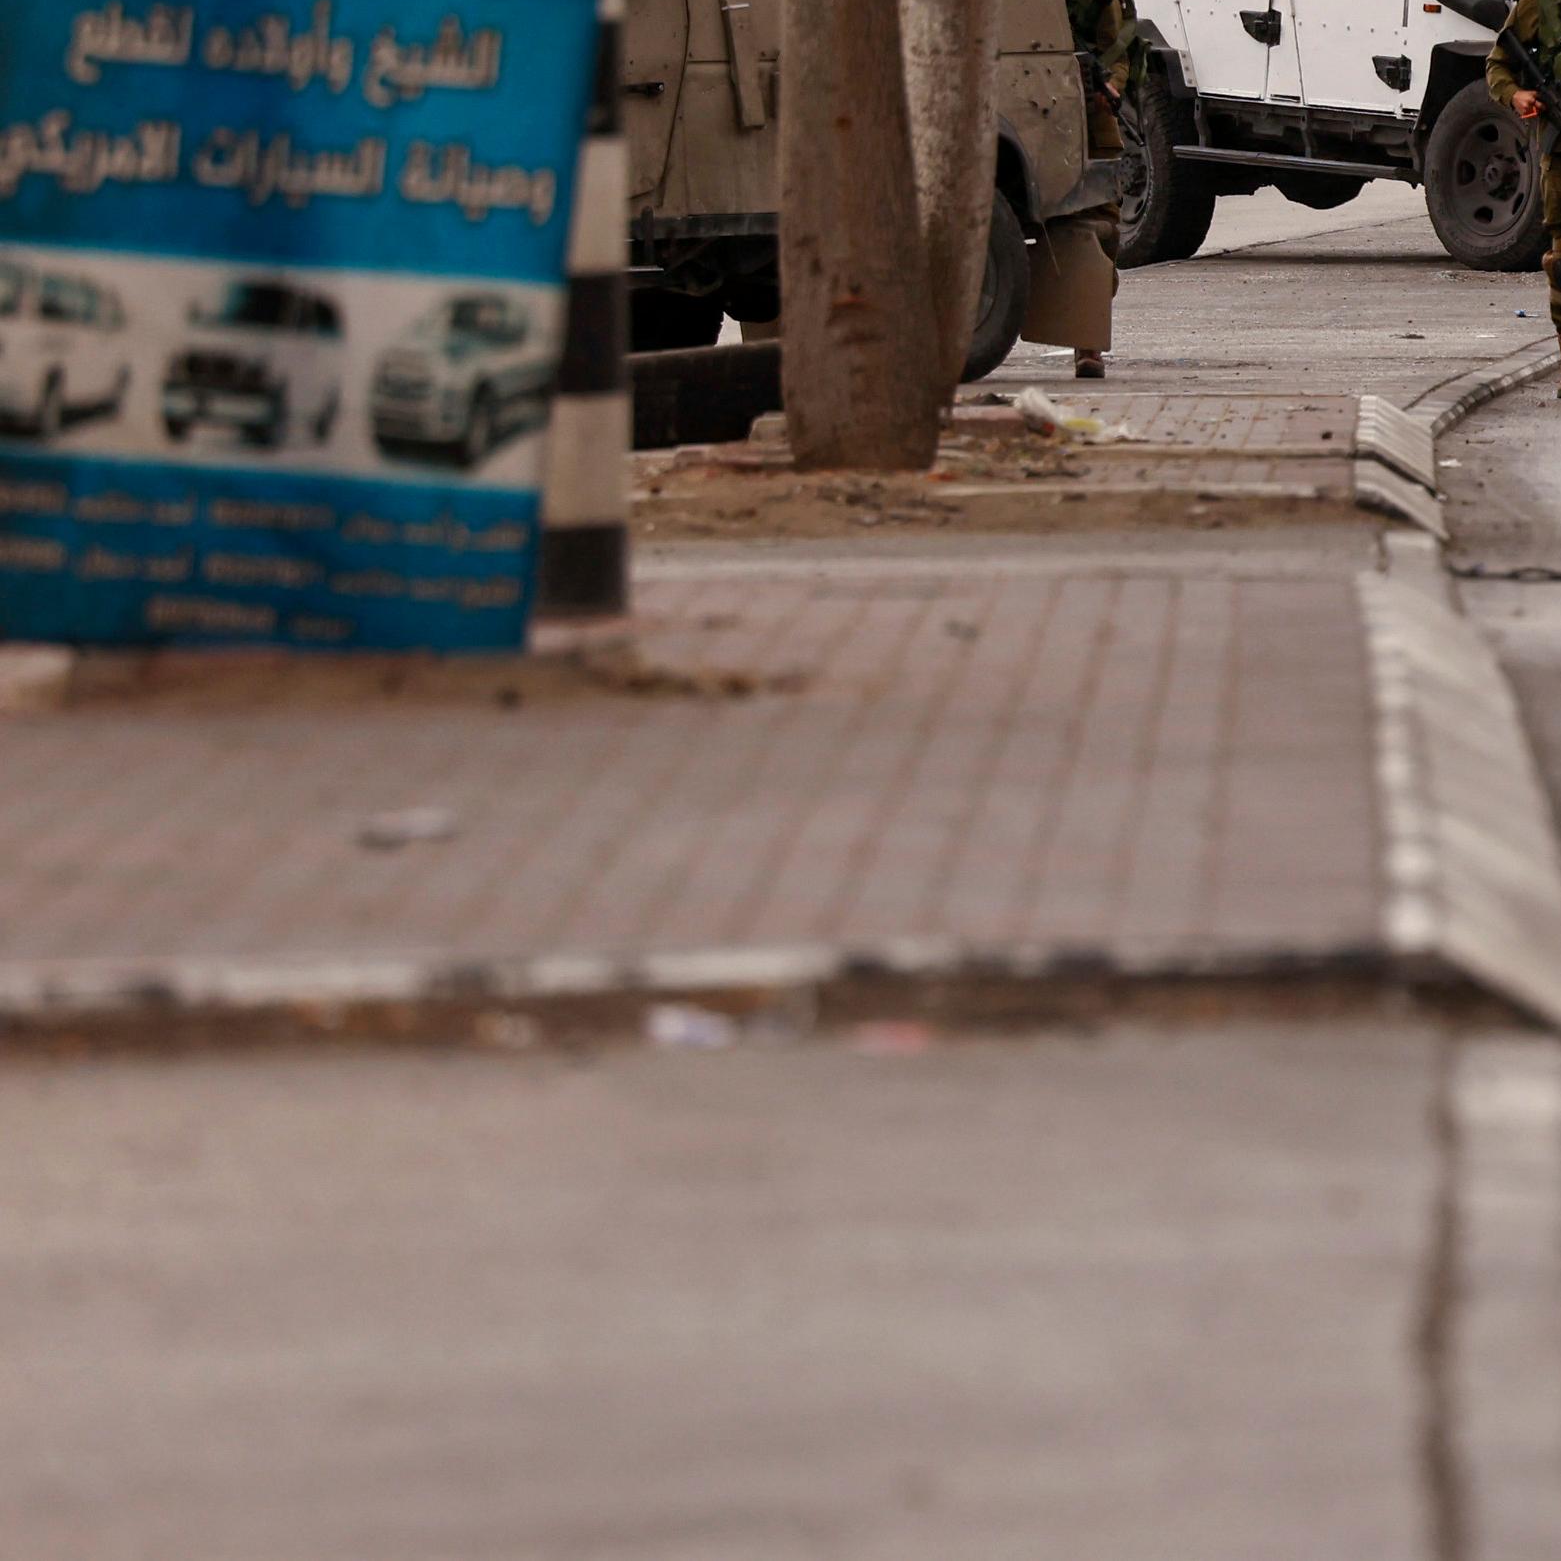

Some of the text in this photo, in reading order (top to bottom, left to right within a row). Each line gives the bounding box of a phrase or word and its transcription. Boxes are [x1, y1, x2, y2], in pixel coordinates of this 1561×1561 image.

[66, 0, 194, 84] لقطع
[364, 14, 502, 107] الشيخ
[193, 124, 387, 205] السيارات
[403, 139, 557, 226] وصيانة
